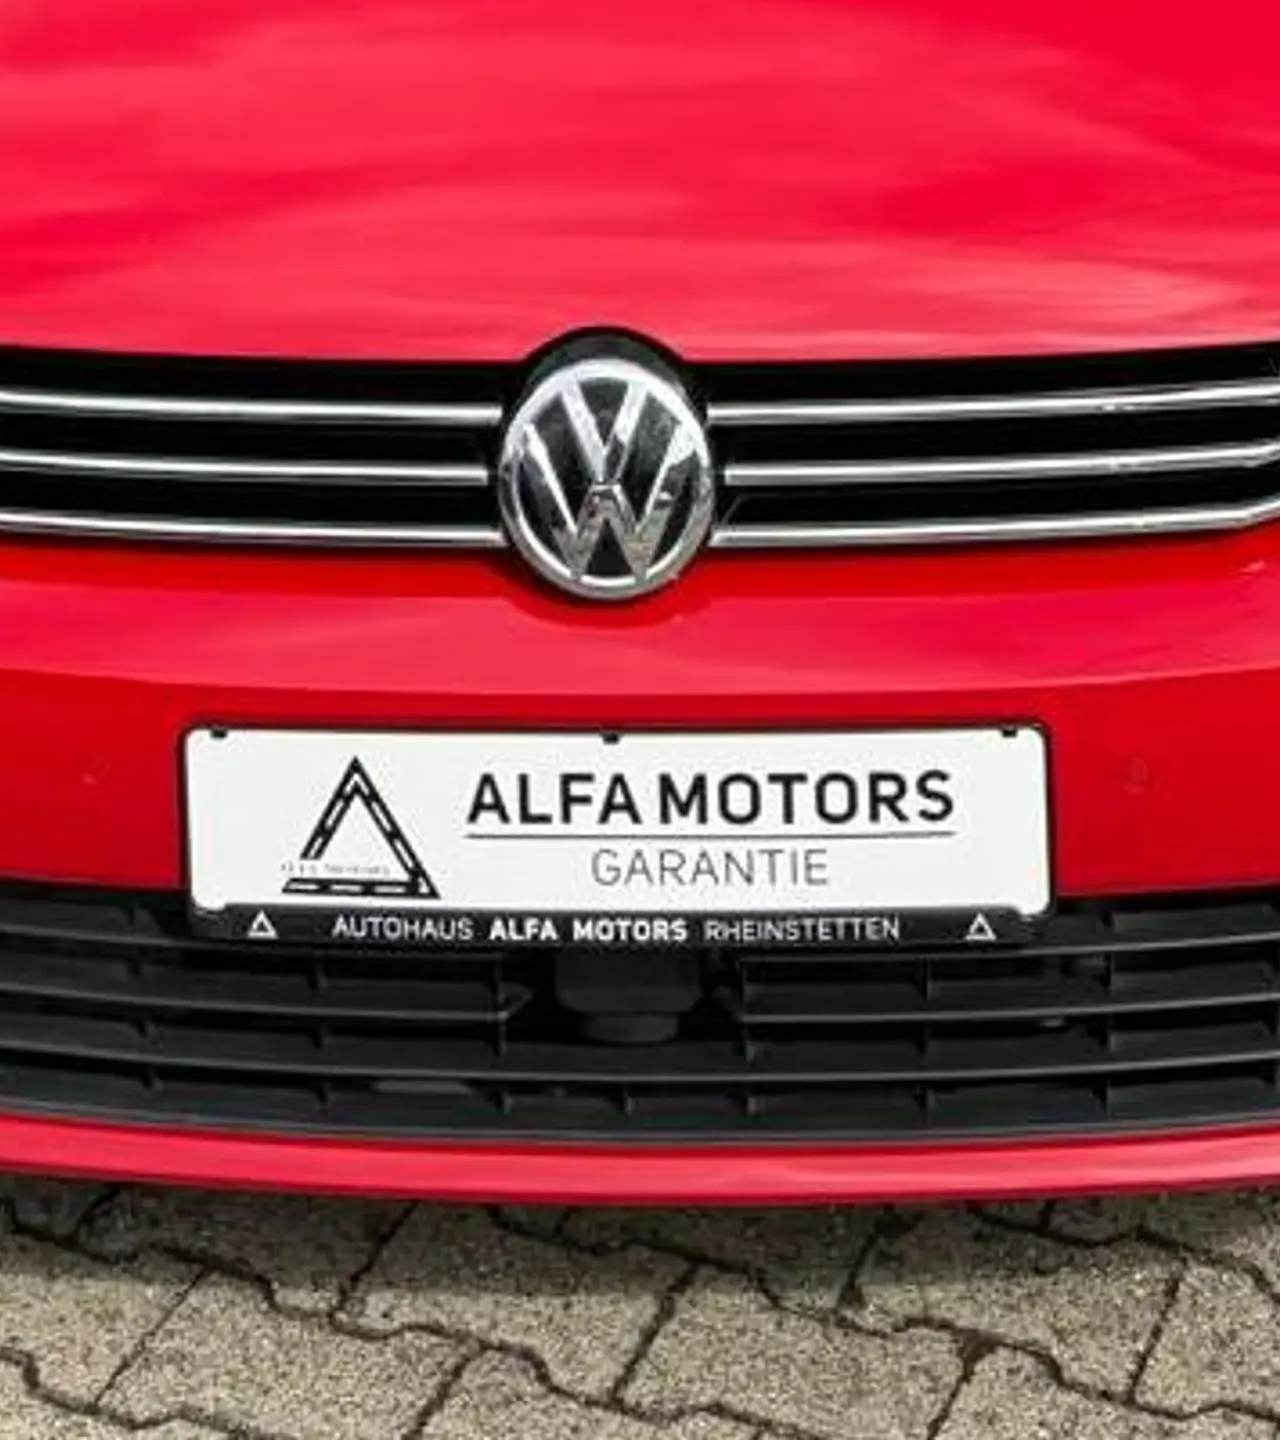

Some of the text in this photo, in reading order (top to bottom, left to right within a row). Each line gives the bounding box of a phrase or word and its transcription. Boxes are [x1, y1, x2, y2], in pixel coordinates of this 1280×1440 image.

[466, 769, 955, 825] ALFA MOTORS
[591, 848, 829, 887] GARANTIE
[331, 916, 900, 942] AUTOHAUS ALFA MOTORS RHEINSTETTEN
